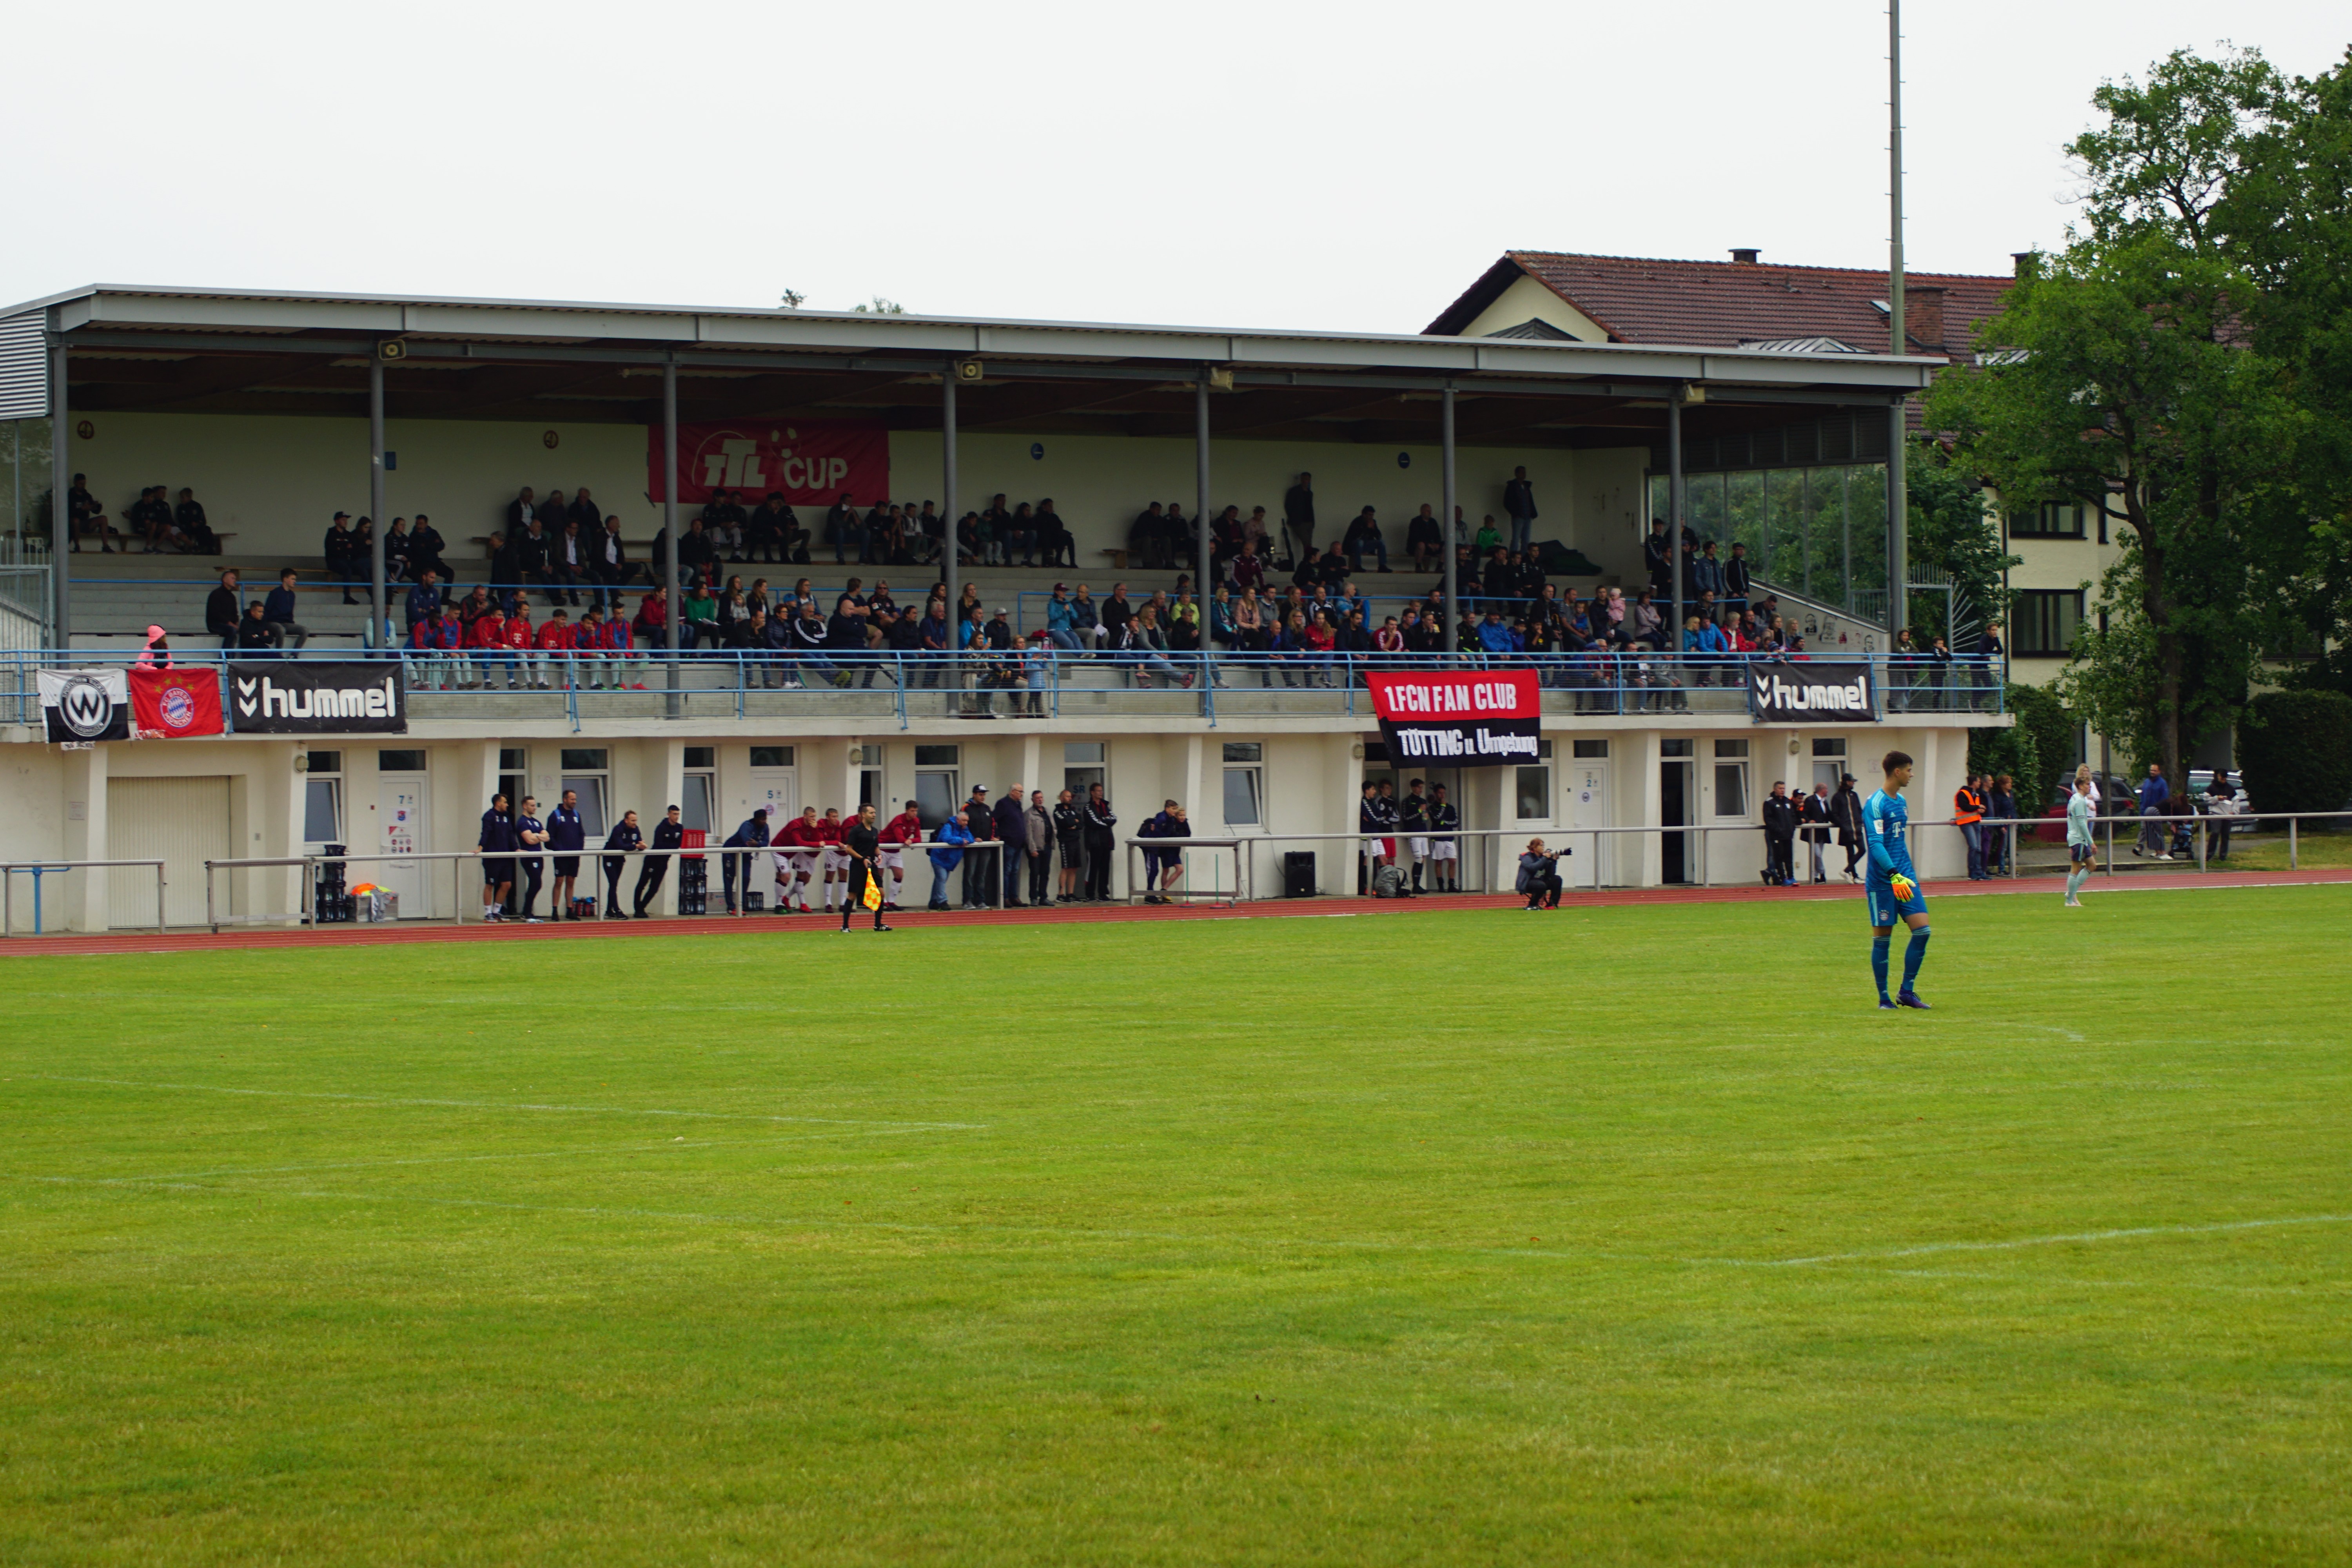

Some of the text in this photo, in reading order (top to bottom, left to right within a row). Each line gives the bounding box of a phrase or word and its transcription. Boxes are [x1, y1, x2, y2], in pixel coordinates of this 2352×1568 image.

[704, 439, 848, 490] TTL CUP
[70, 689, 99, 722] W
[262, 676, 396, 718] hummel
[1384, 683, 1517, 712] 1.FCN FAN CLUB
[1773, 675, 1867, 710] hummel
[1397, 728, 1463, 756] TÖTTING
[1476, 728, 1538, 757] Umgebung
[398, 795, 405, 804] 7
[767, 790, 774, 799] 5
